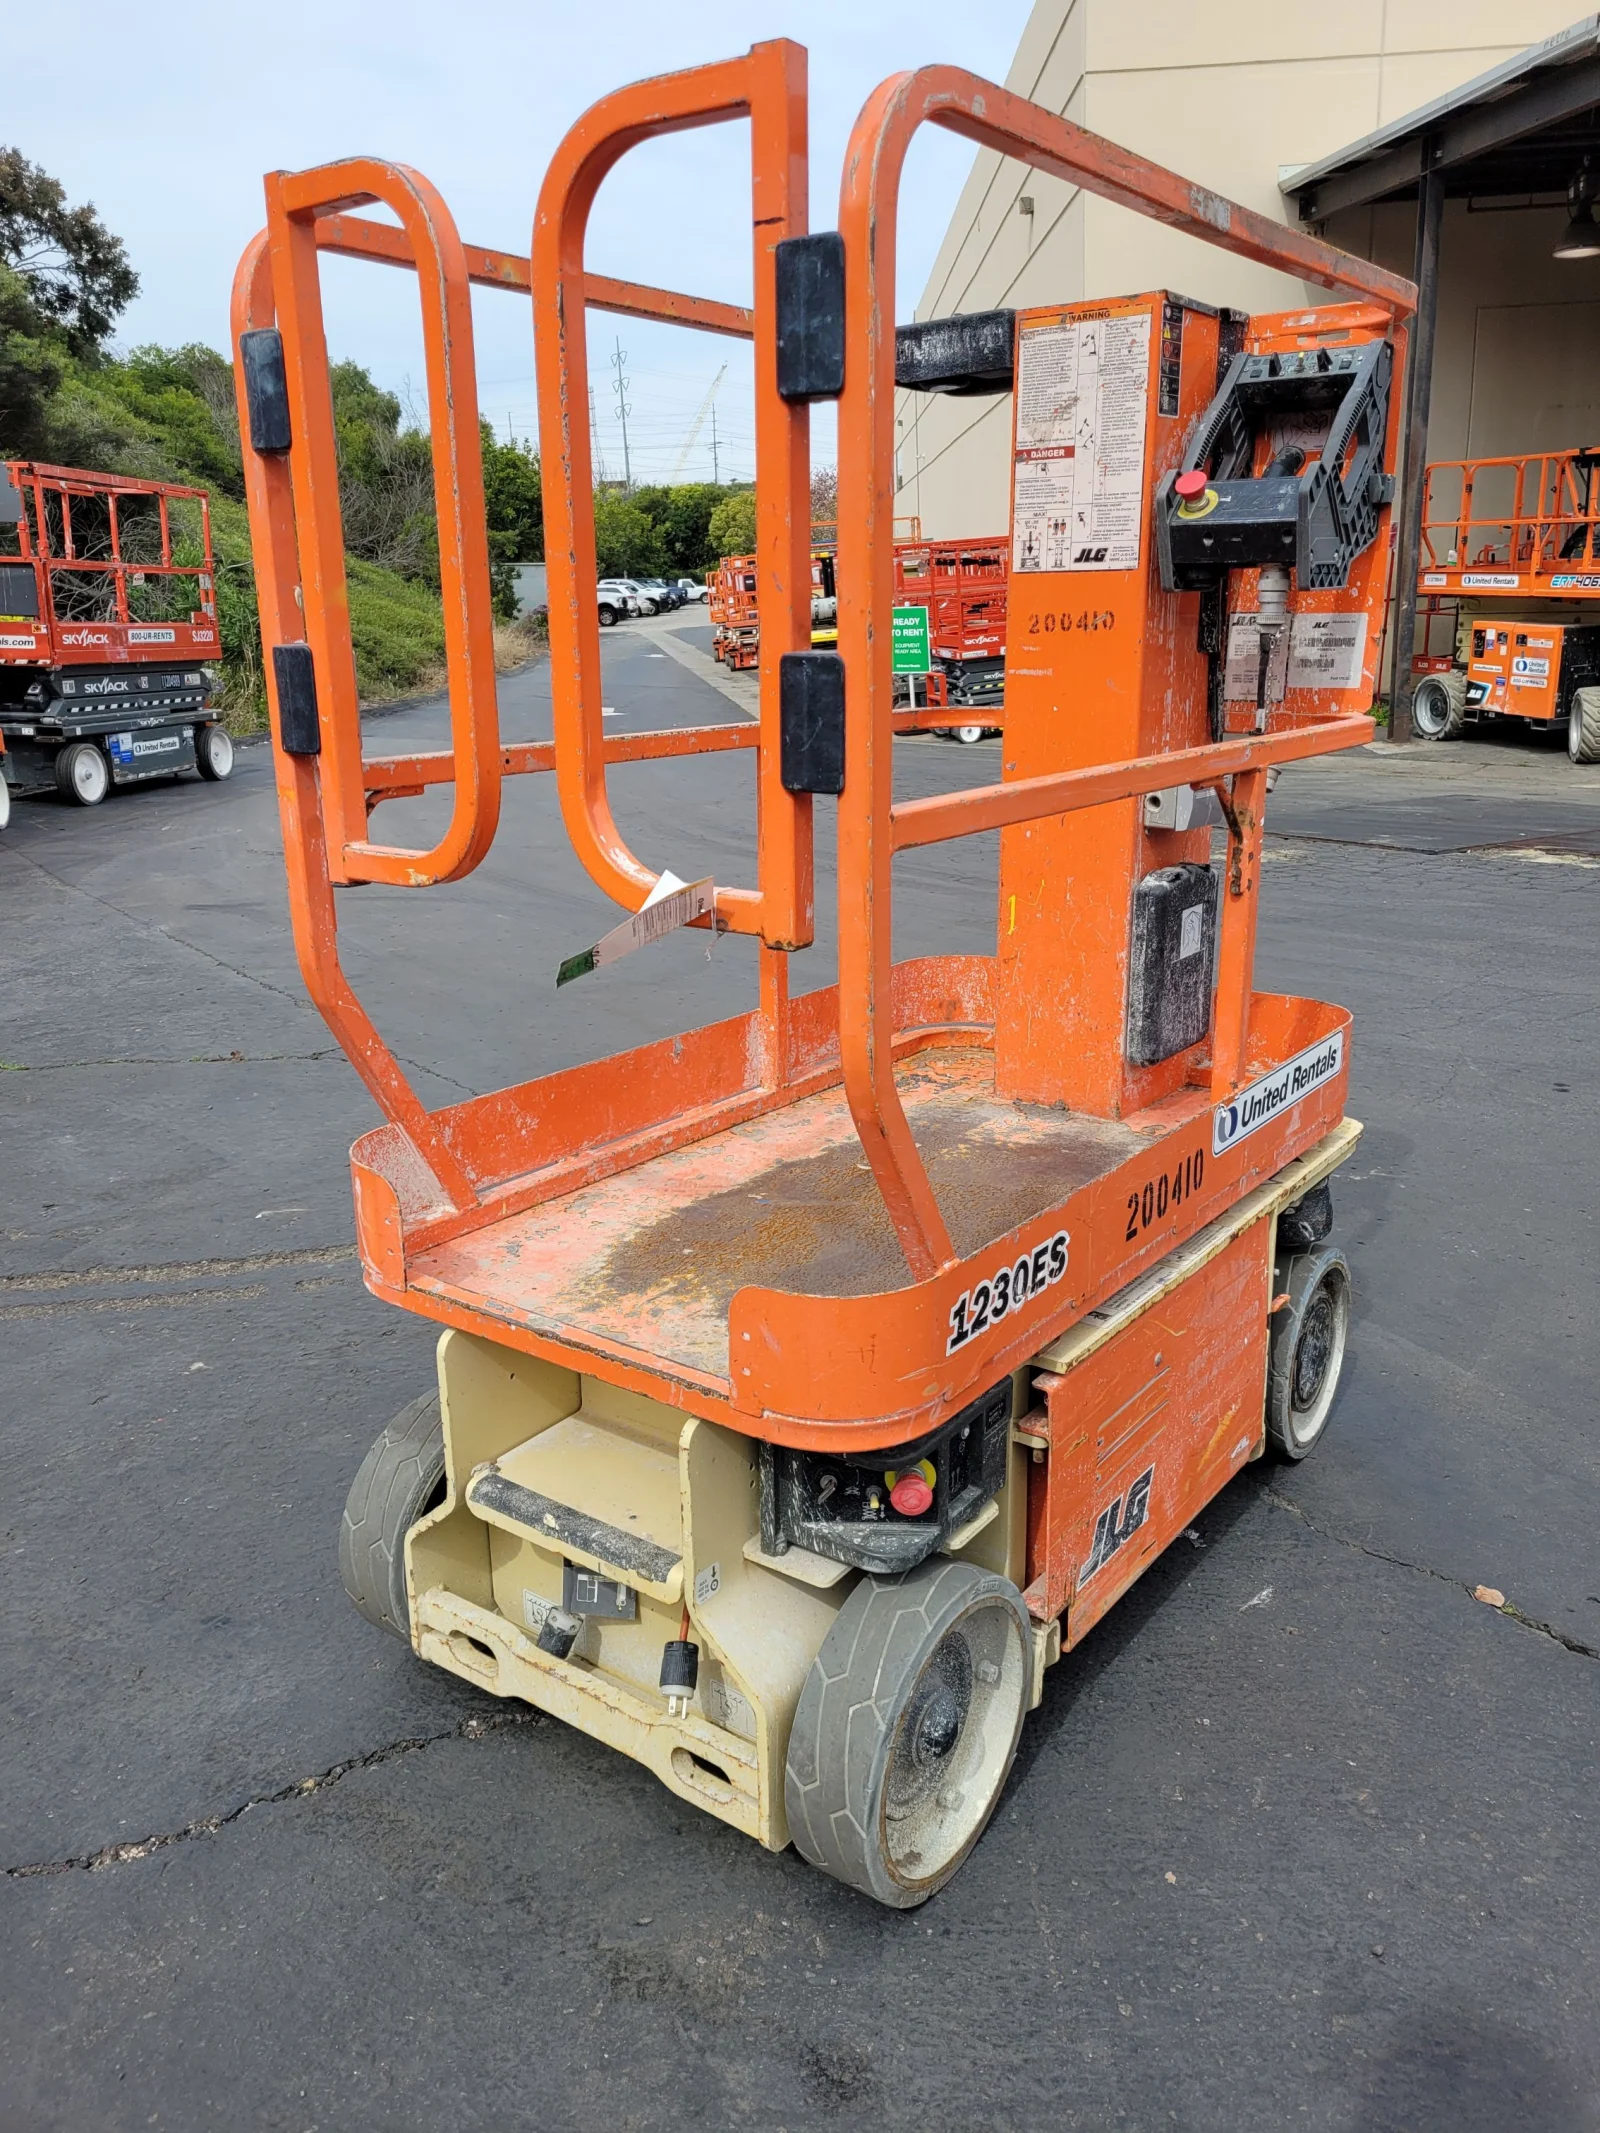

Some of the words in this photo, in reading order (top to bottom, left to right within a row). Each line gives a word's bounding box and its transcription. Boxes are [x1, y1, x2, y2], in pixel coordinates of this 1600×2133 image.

[1068, 310, 1111, 322] WARNING
[1030, 448, 1065, 459] DANGER
[1073, 548, 1109, 563] JLG
[1471, 576, 1493, 585] United
[1493, 577, 1516, 585] Rentals
[893, 618, 920, 626] READY
[62, 628, 109, 647] SKYJACK
[130, 631, 173, 641] 800-UR-RENTS
[192, 630, 214, 642] SJ3220
[903, 629, 924, 637] RENT
[964, 635, 1000, 645] SKYJACK
[1527, 666, 1547, 674] Rentals
[1528, 660, 1545, 668] United
[84, 677, 129, 694] SKYJACK
[142, 742, 159, 752] United
[159, 740, 177, 749] Rentals
[1241, 1073, 1290, 1128] United
[1291, 1044, 1337, 1094] Rentals
[1125, 1147, 1204, 1242] 200410
[946, 1232, 1070, 1355] 1230ES
[1077, 1462, 1155, 1592] JLG
